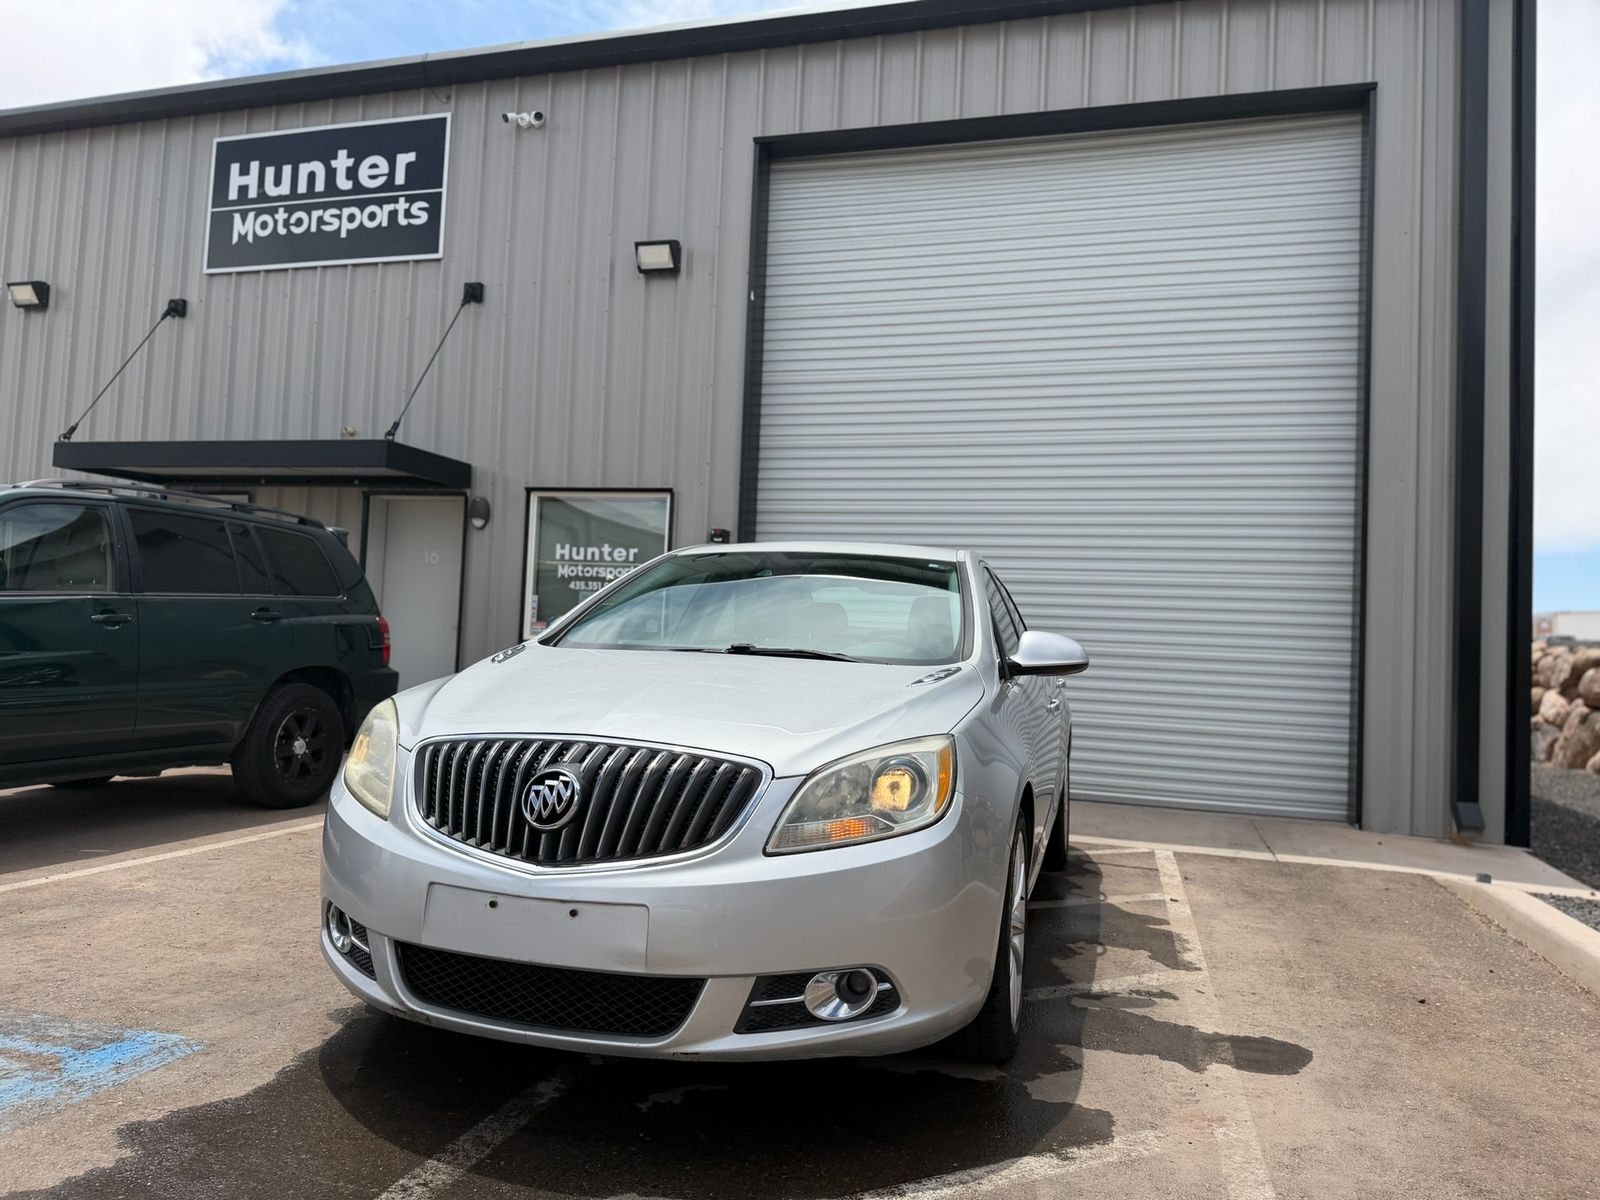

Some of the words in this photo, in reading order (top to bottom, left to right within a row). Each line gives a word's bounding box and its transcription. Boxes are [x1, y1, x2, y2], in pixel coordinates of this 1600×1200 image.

[228, 149, 416, 201] Hunter
[232, 197, 430, 245] Motorsports
[425, 549, 439, 563] 16
[555, 543, 639, 562] Hunter
[557, 564, 636, 580] Motorspor
